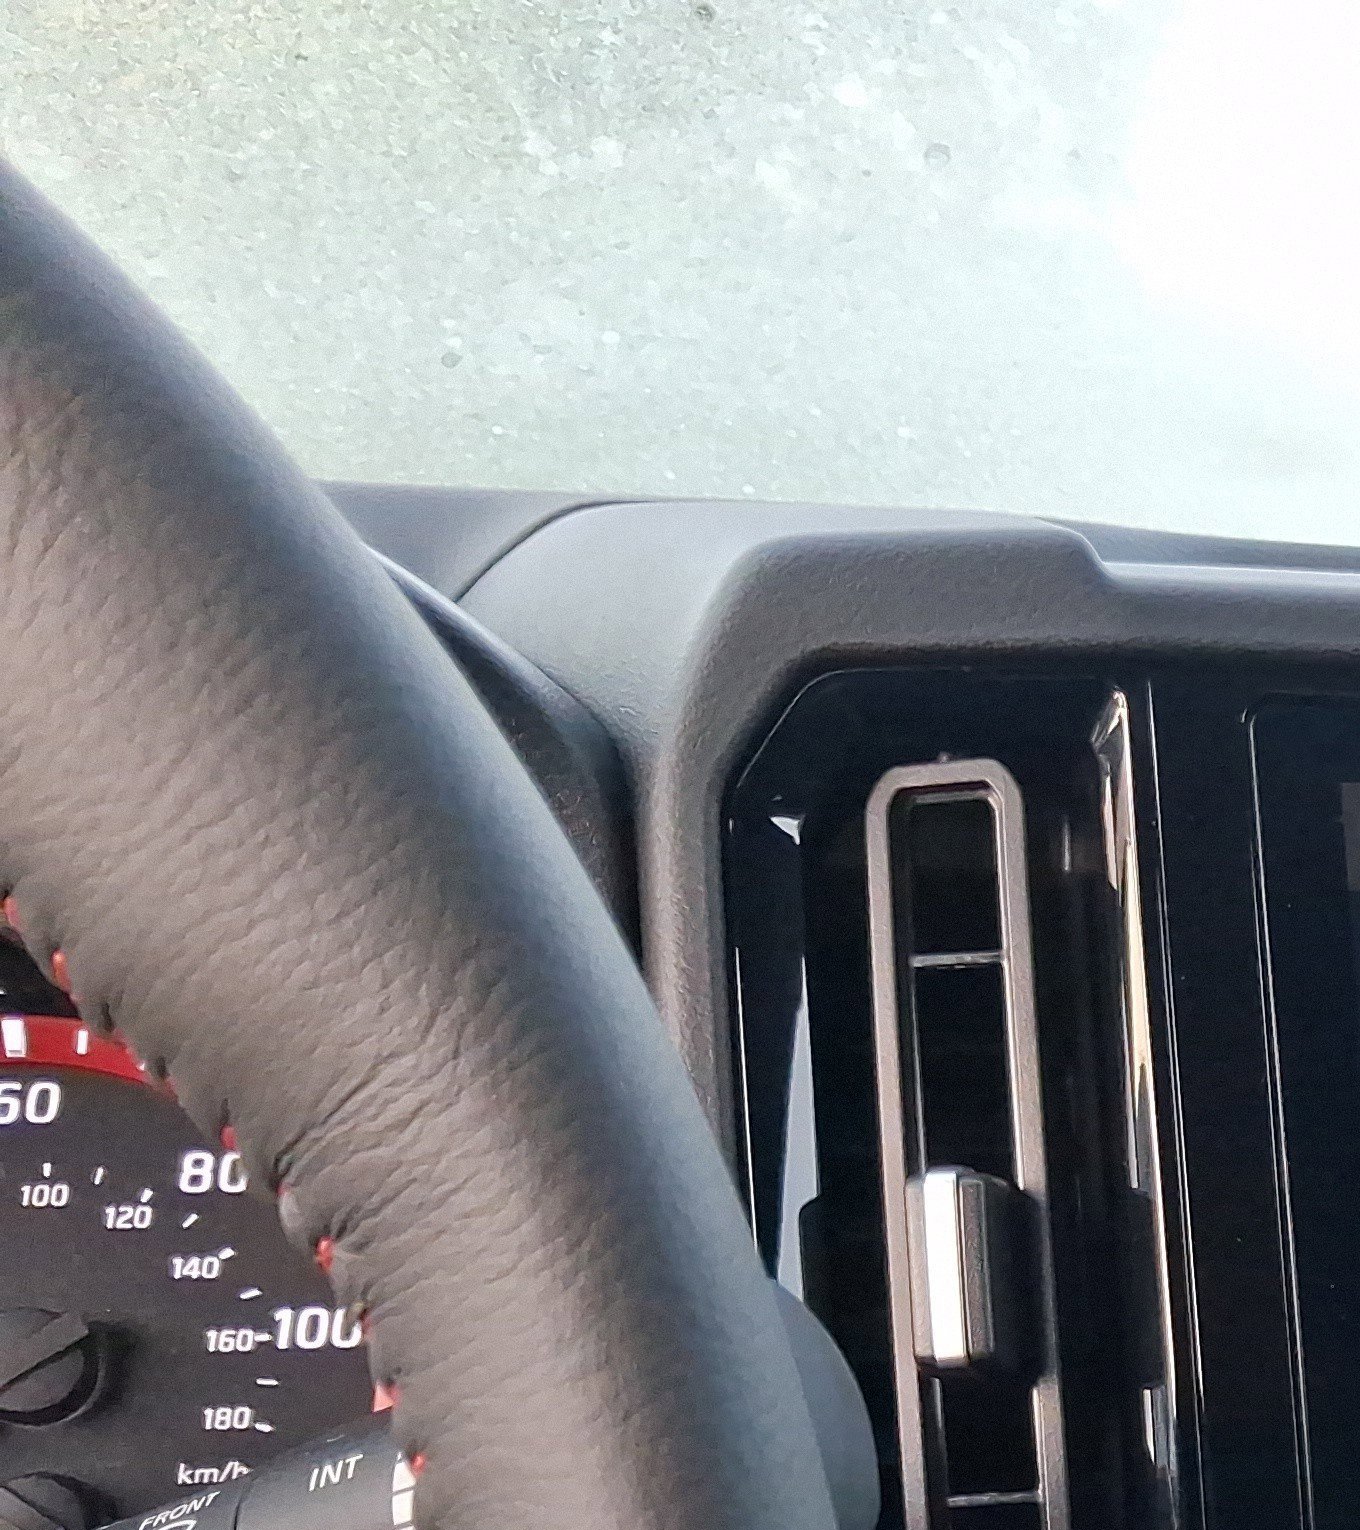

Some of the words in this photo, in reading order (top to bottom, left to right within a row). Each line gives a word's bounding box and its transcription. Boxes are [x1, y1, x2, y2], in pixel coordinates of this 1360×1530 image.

[0, 1081, 61, 1124] 60
[178, 1151, 249, 1193] 80
[20, 1184, 69, 1208] 100
[105, 1206, 152, 1230] 120
[172, 1256, 221, 1279] 140
[274, 1306, 362, 1349] 100
[206, 1328, 253, 1353] 160
[203, 1408, 251, 1430] 180
[309, 1455, 363, 1492] INT
